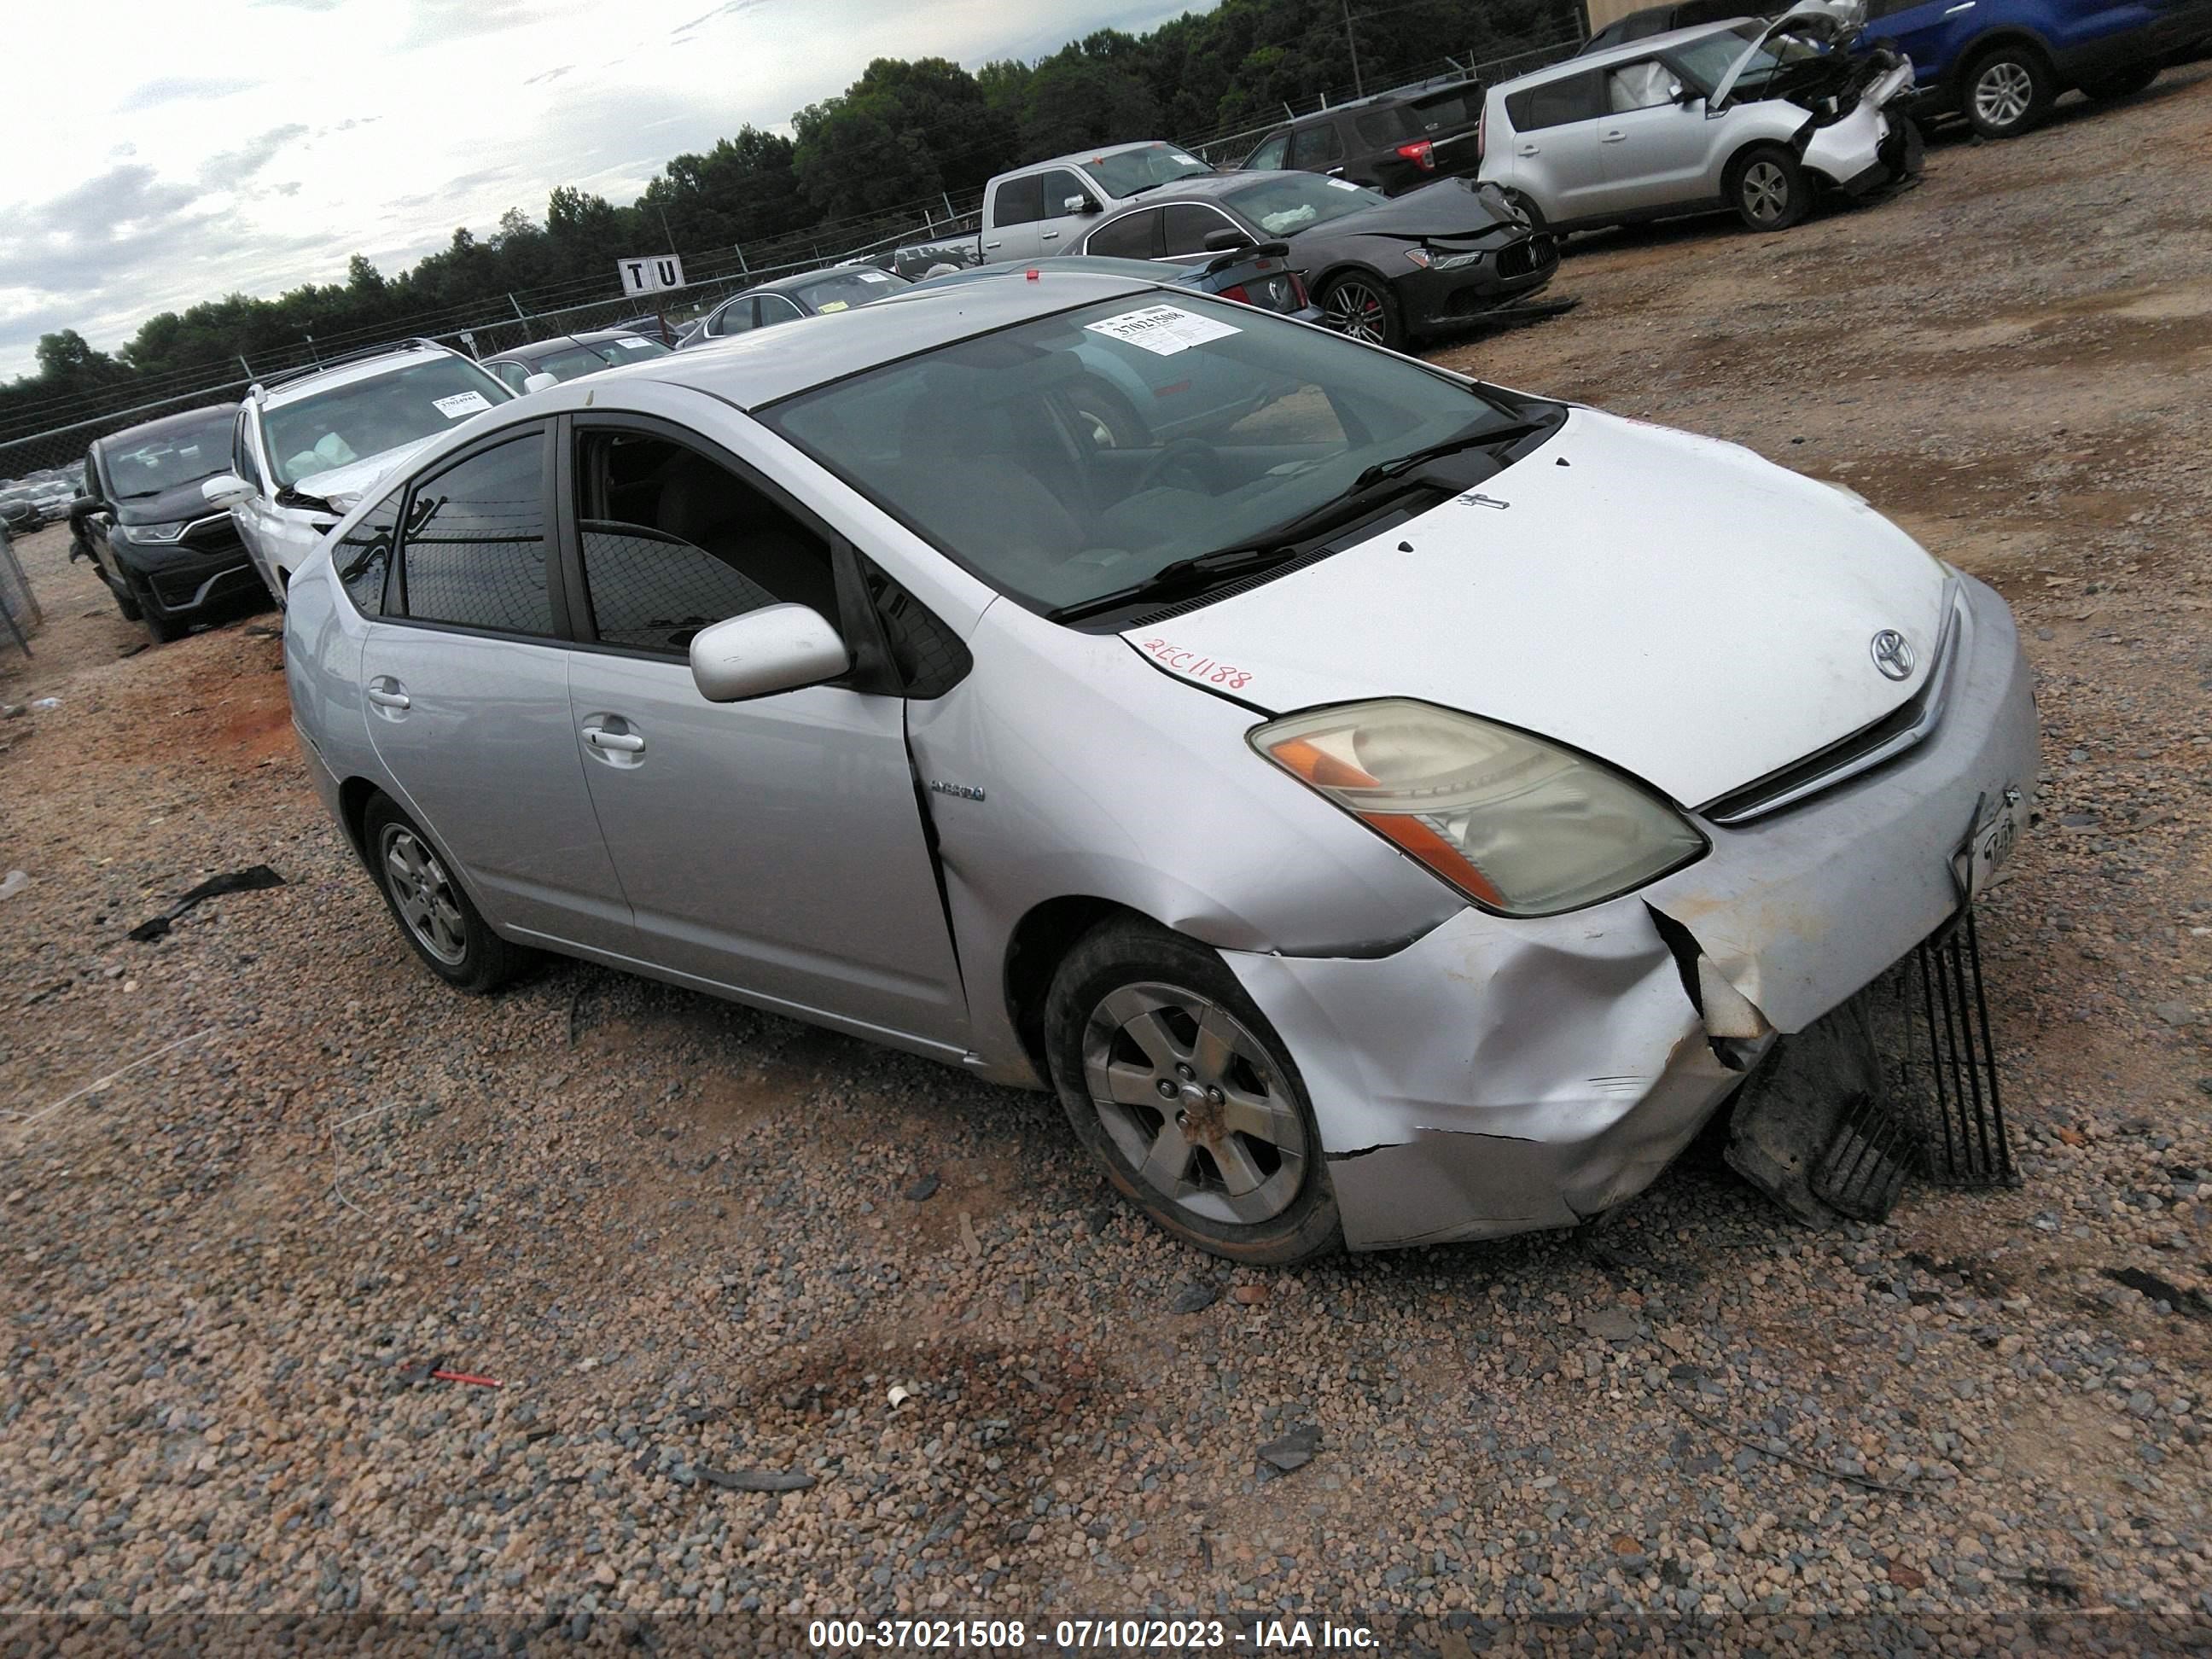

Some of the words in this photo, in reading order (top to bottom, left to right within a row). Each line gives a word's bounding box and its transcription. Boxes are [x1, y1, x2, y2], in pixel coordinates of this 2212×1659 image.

[627, 263, 643, 288] T
[657, 260, 677, 286] U
[1112, 311, 1186, 336] 37021508
[1144, 638, 1253, 690] 2EC1188
